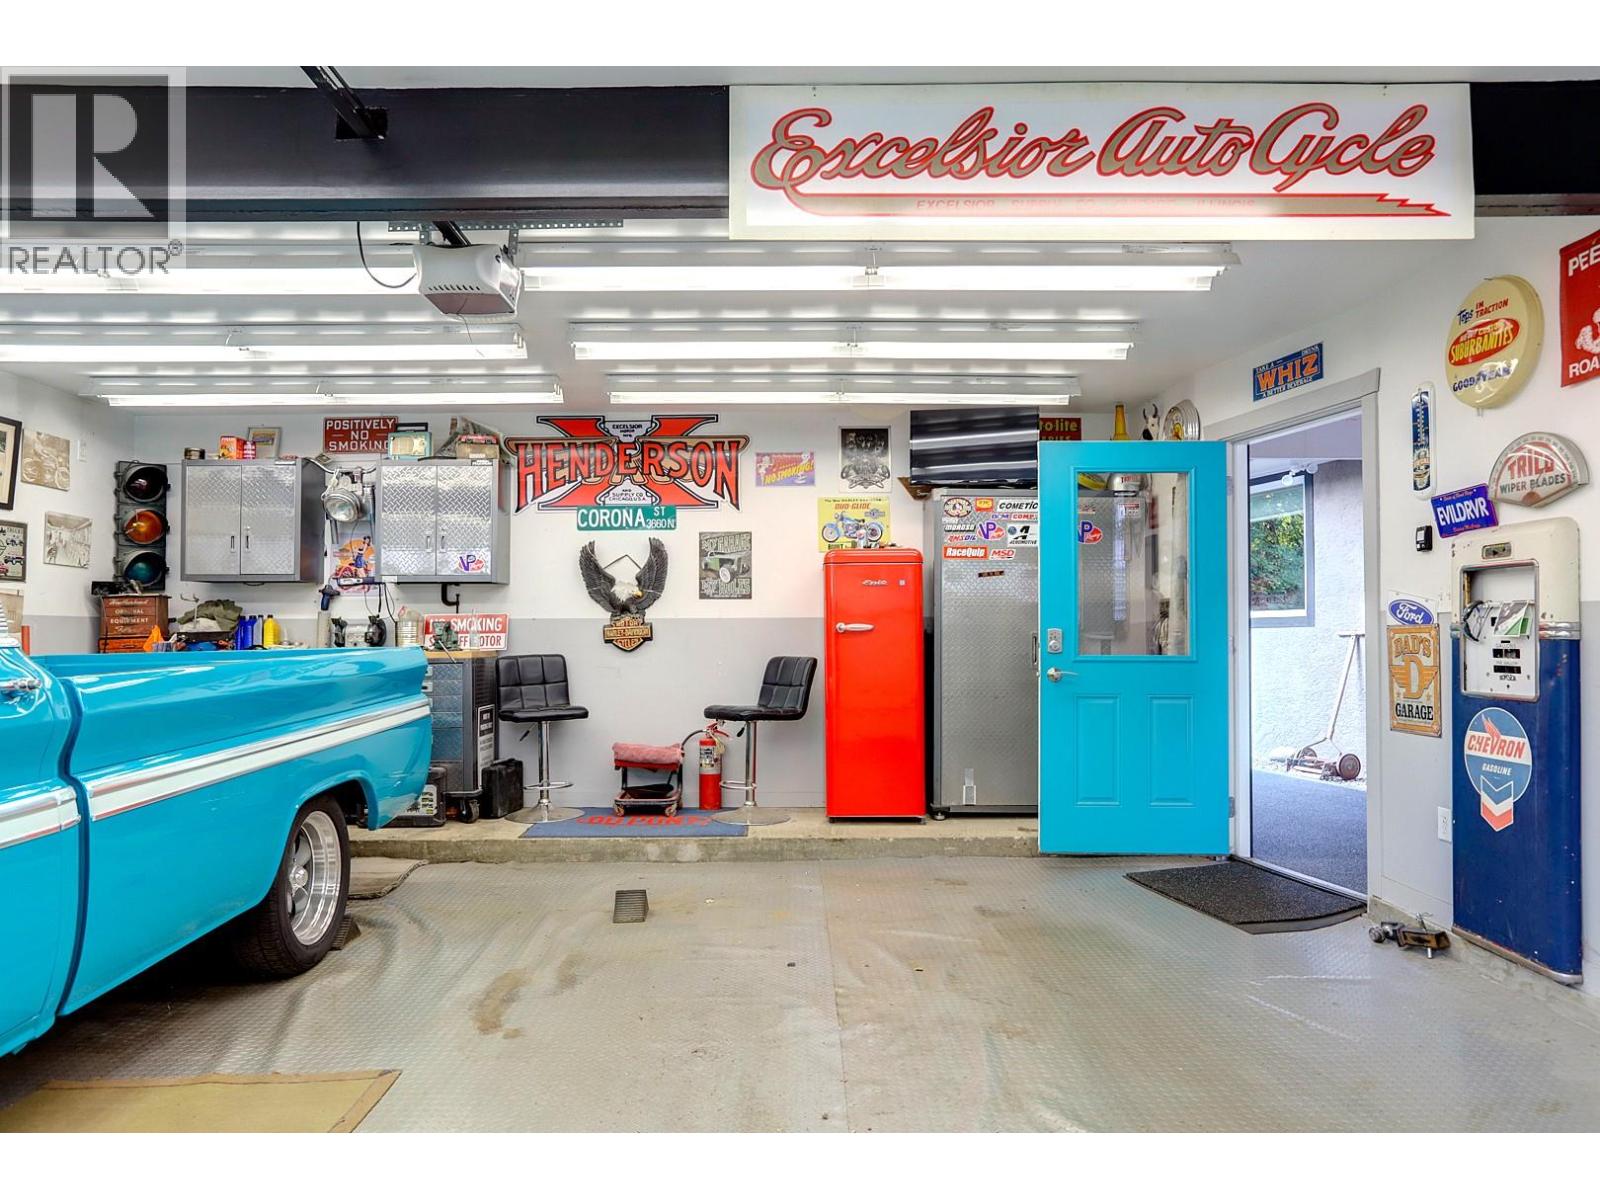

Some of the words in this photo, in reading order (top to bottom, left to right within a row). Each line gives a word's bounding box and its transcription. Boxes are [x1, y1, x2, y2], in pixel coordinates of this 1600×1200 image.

[752, 106, 1096, 189] Excelsior
[1096, 106, 1255, 177] Auto
[1250, 103, 1436, 192] Cycle
[916, 200, 996, 210] EXCELSIOR
[1475, 298, 1508, 318] TRACTION
[1450, 326, 1514, 364] SUBURBANITES
[1257, 353, 1318, 391] WHIZ
[326, 419, 394, 429] POSITIVELY
[350, 431, 369, 439] NO
[515, 440, 740, 513] HENDERSON
[1500, 482, 1526, 494] WIPER
[1529, 474, 1565, 489] BLADES
[577, 508, 646, 527] CORONA
[653, 506, 666, 516] ST
[1437, 497, 1489, 526] EVILDRVR
[979, 522, 996, 540] VP
[1396, 602, 1424, 625] Ford
[450, 618, 503, 633] SMOKING
[1395, 703, 1433, 721] GARAGE
[1468, 734, 1525, 759] CHEVRON
[1482, 763, 1512, 776] GASOLINE
